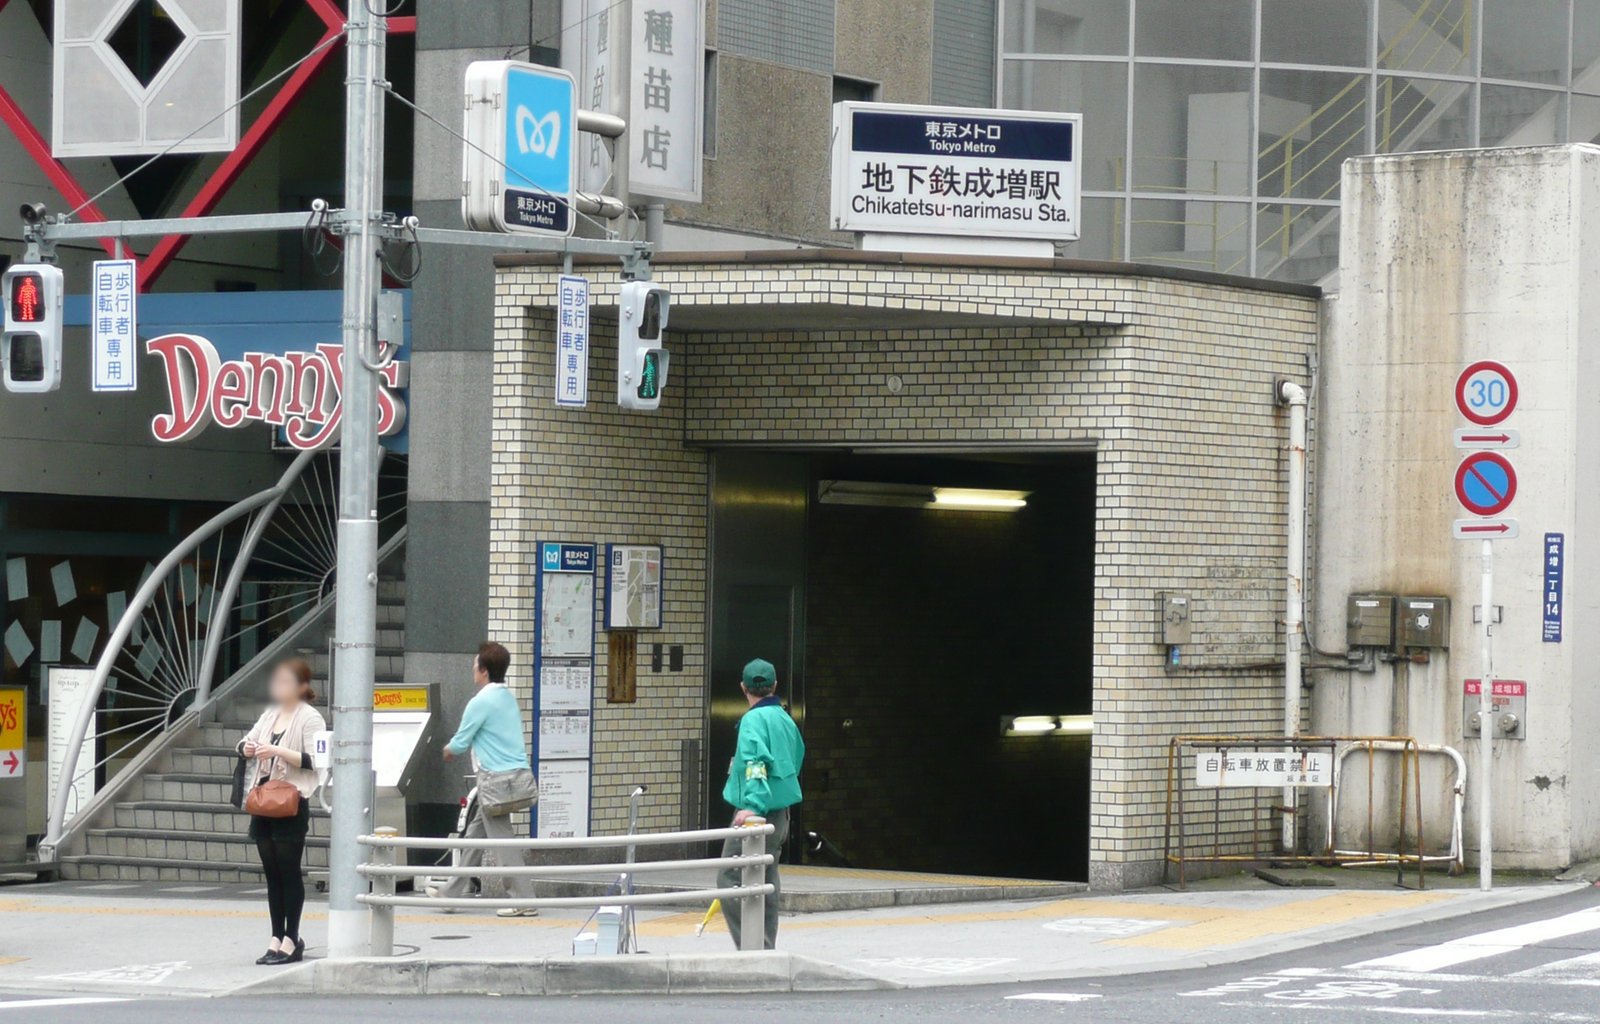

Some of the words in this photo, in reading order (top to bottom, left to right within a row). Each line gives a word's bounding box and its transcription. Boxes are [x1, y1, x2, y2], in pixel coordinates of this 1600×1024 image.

[640, 8, 674, 171] 種苗店
[925, 121, 1001, 140] 東京メトロ
[929, 139, 961, 153] Tokyo
[963, 141, 996, 154] Metro
[861, 161, 1062, 202] 地下鉄成増駅
[517, 196, 556, 214] 東京メトロ
[851, 194, 1033, 221] Chikatetsu-narimasu
[1038, 204, 1071, 222] Sta.
[97, 272, 114, 336] 自転車
[115, 272, 131, 335] 歩行者
[561, 287, 573, 349] 自転車
[574, 288, 586, 351] 歩行者
[106, 338, 122, 380] 専用
[566, 354, 578, 396] 専用
[1470, 379, 1505, 408] 30
[1206, 757, 1321, 773] 自転車放置禁止
